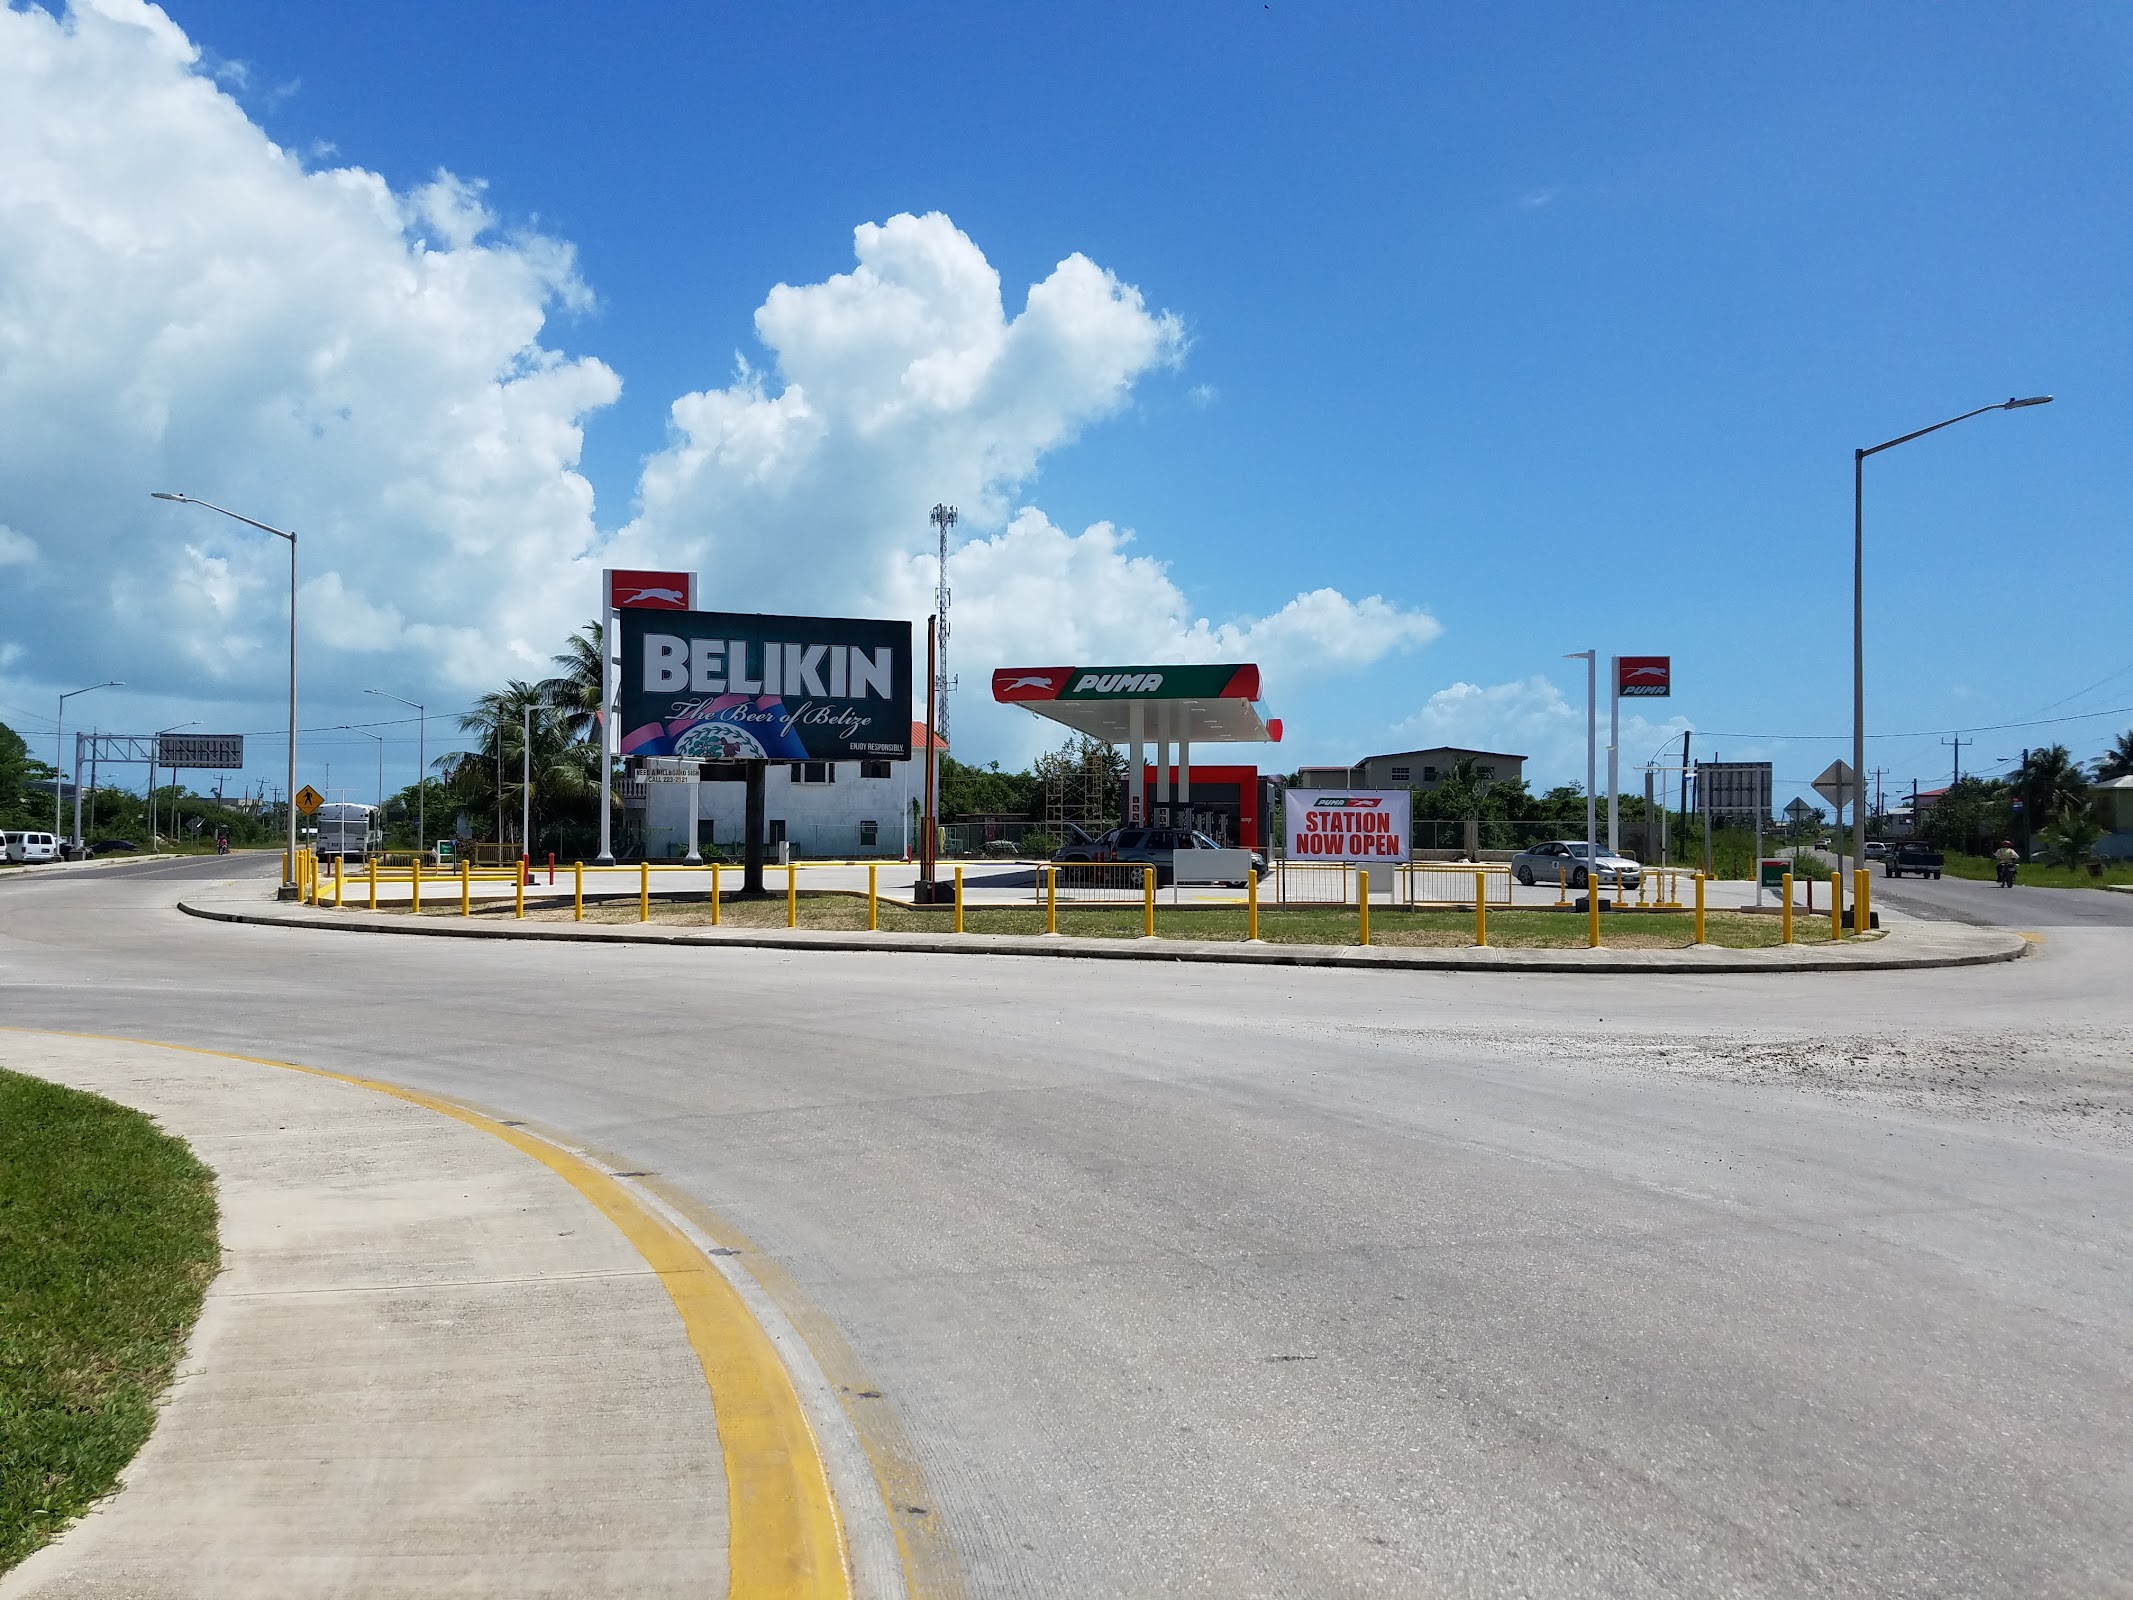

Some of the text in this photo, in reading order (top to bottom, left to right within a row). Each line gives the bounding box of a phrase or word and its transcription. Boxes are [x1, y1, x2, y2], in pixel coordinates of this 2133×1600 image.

[643, 633, 893, 700] BELIKIN
[1072, 674, 1164, 693] PUMA
[1622, 685, 1667, 695] PUMA
[664, 697, 873, 740] The Beer of Belize
[849, 742, 905, 752] ENJOY RESPONSIBLY.
[1305, 811, 1390, 833] STATION
[1296, 834, 1400, 856] NOW OPEN
